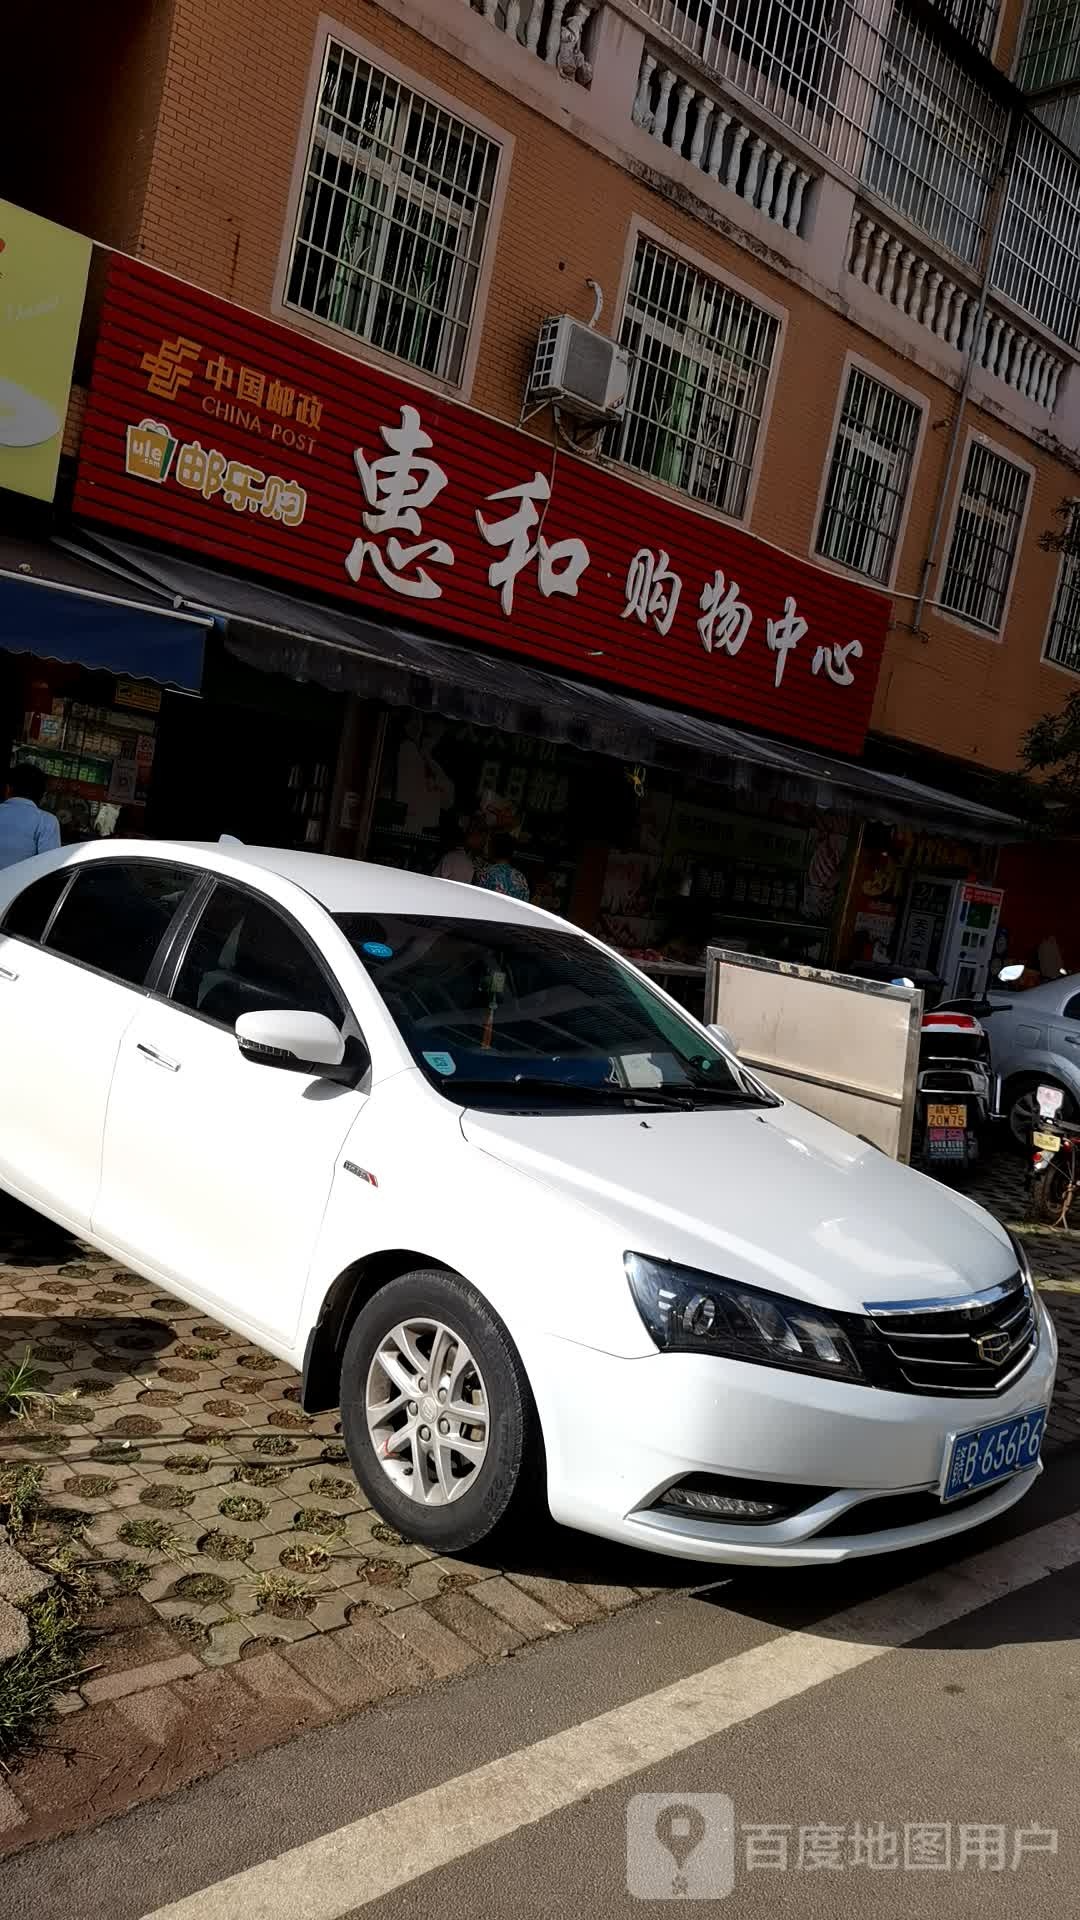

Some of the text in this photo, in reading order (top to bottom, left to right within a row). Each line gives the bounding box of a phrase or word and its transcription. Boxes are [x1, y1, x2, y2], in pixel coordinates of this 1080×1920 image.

[203, 396, 316, 455] CHINA POST
[206, 356, 323, 431] 中国邮政
[131, 440, 161, 461] ule
[176, 441, 307, 526] 邮乐购
[345, 404, 864, 688] 惠和 购物中心
